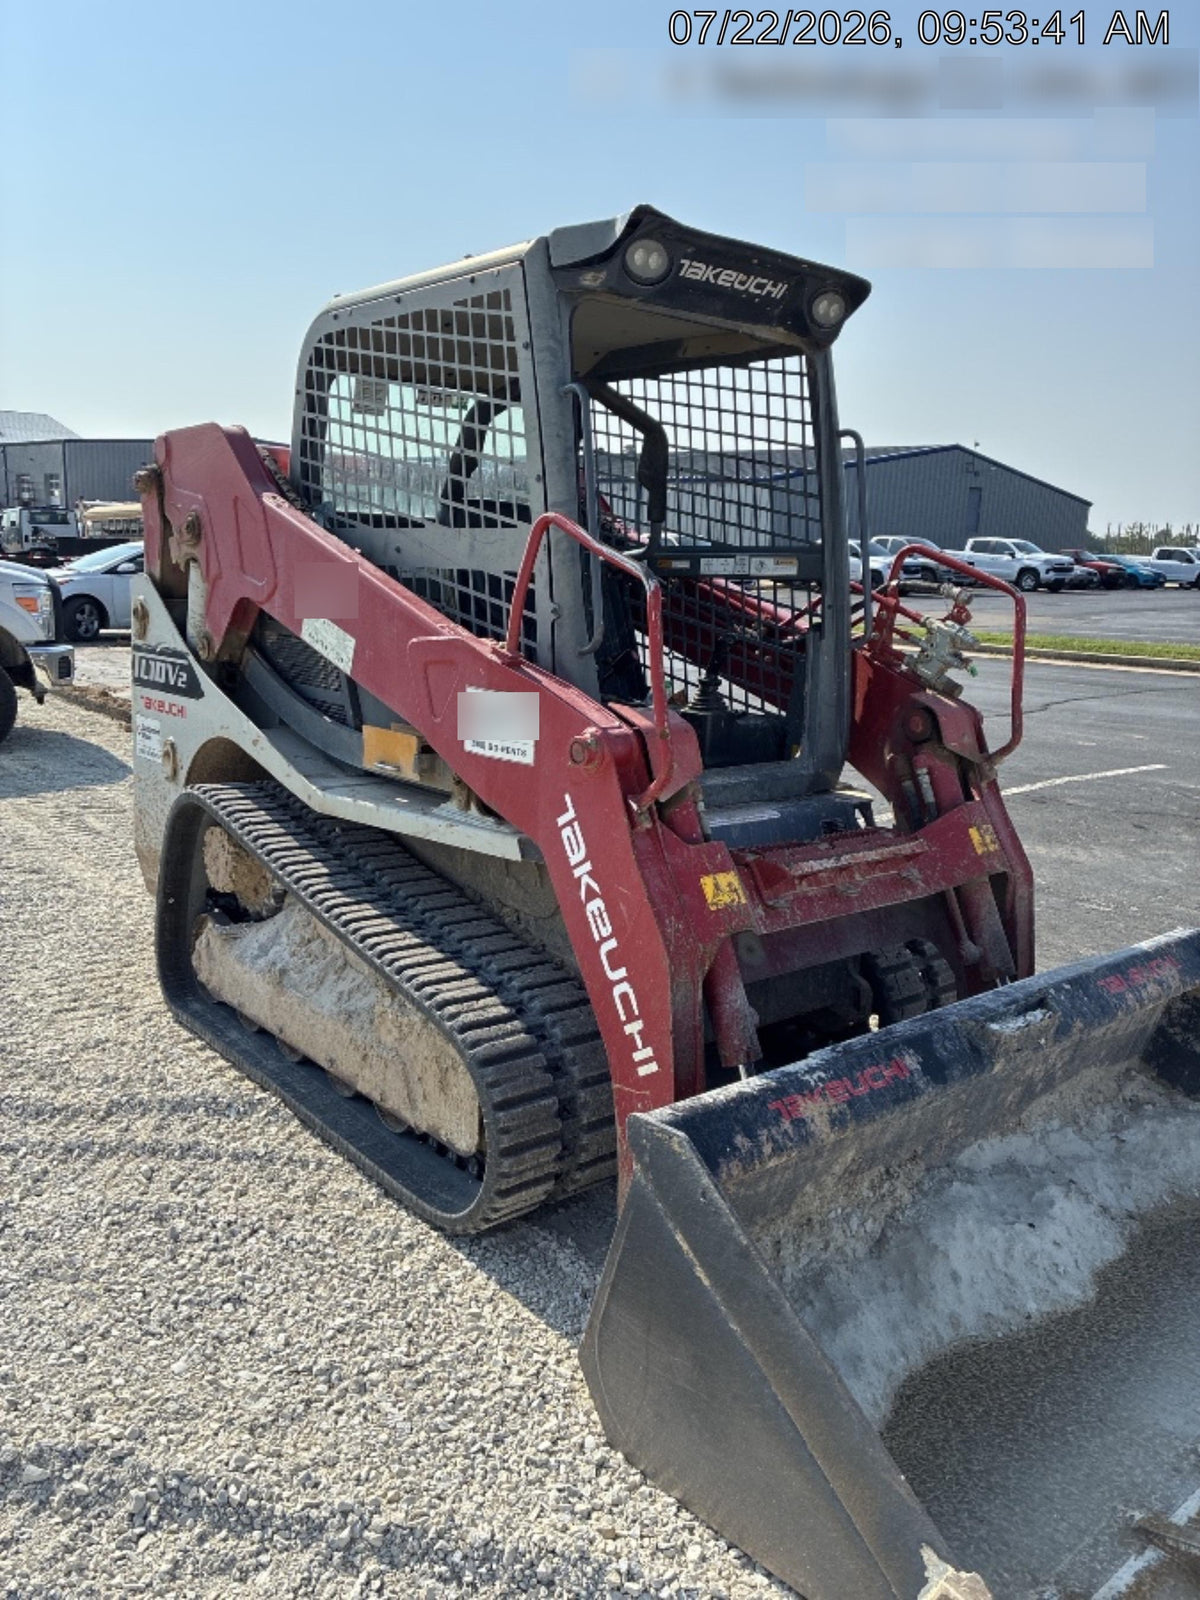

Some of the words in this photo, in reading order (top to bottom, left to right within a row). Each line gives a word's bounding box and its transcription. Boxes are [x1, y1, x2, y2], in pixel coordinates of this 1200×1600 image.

[678, 258, 788, 299] TAKEUCHI
[140, 695, 188, 719] AKEUCHI
[557, 792, 659, 1078] TAKEUCHI
